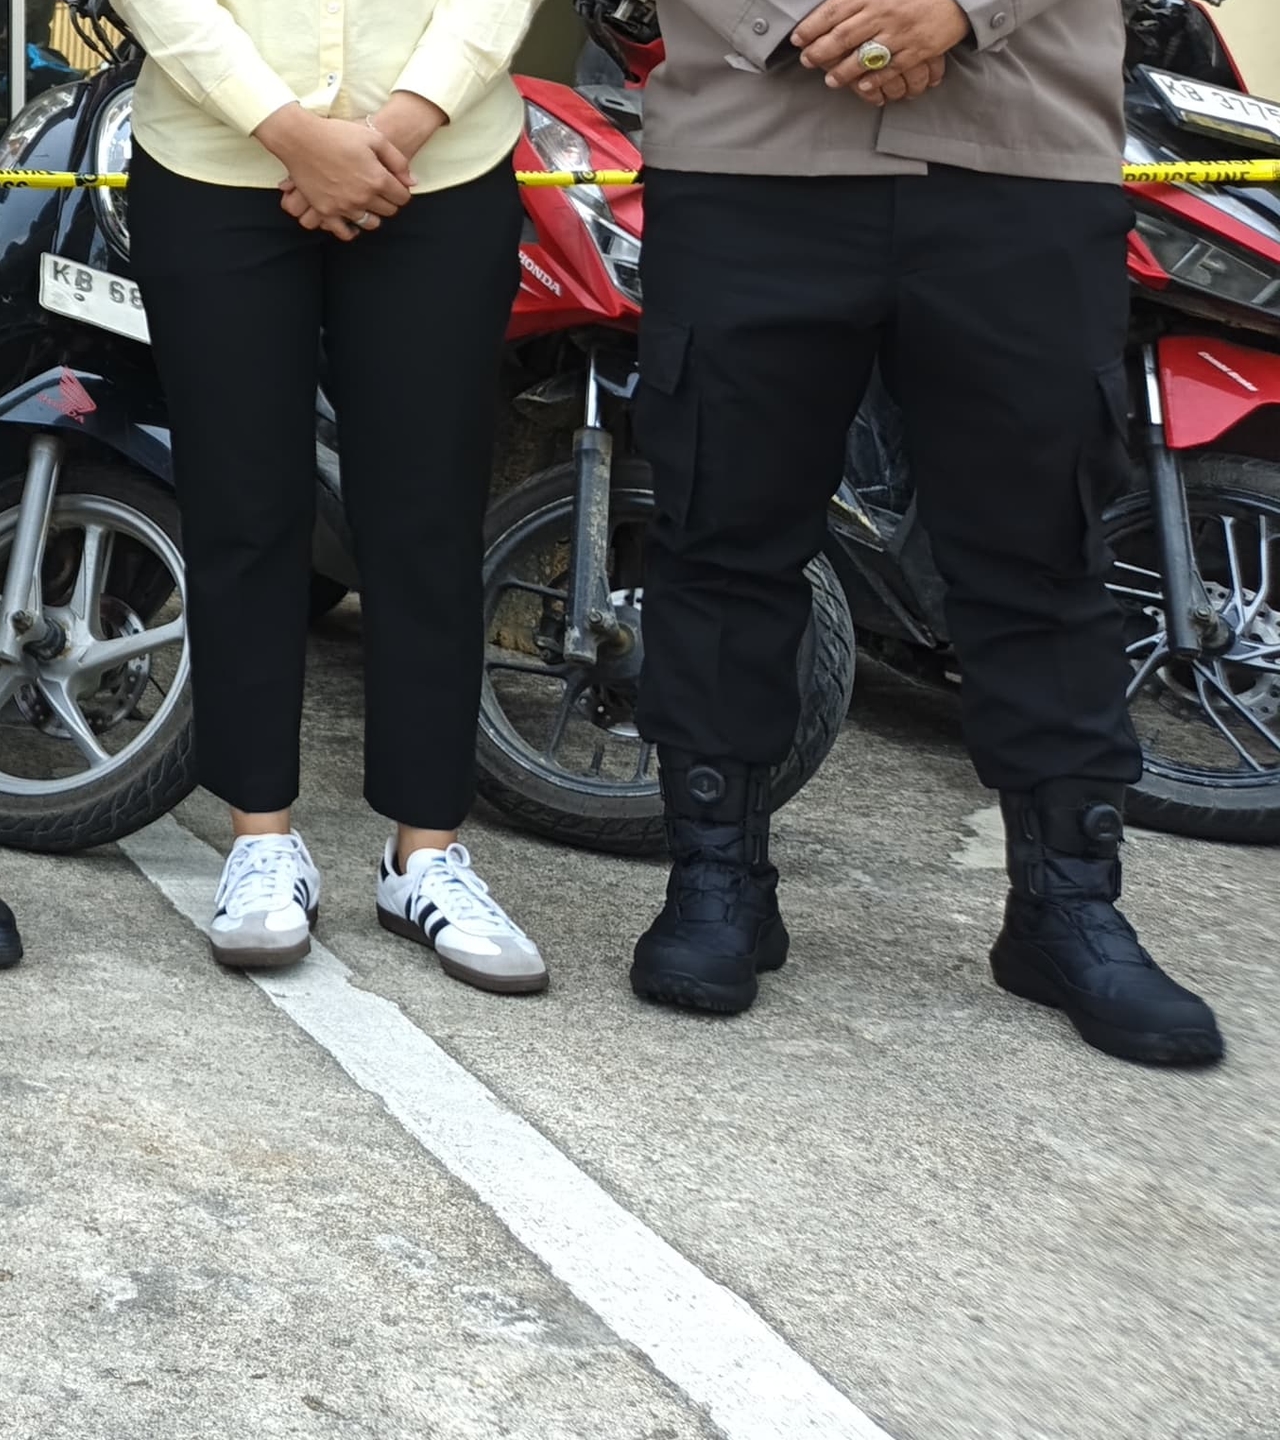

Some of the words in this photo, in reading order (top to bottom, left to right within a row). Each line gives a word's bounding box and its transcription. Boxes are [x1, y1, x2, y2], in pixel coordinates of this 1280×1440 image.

[1159, 77, 1205, 102] KB
[53, 260, 93, 293] KB
[109, 280, 144, 311] 68
[519, 250, 561, 297] HONDA
